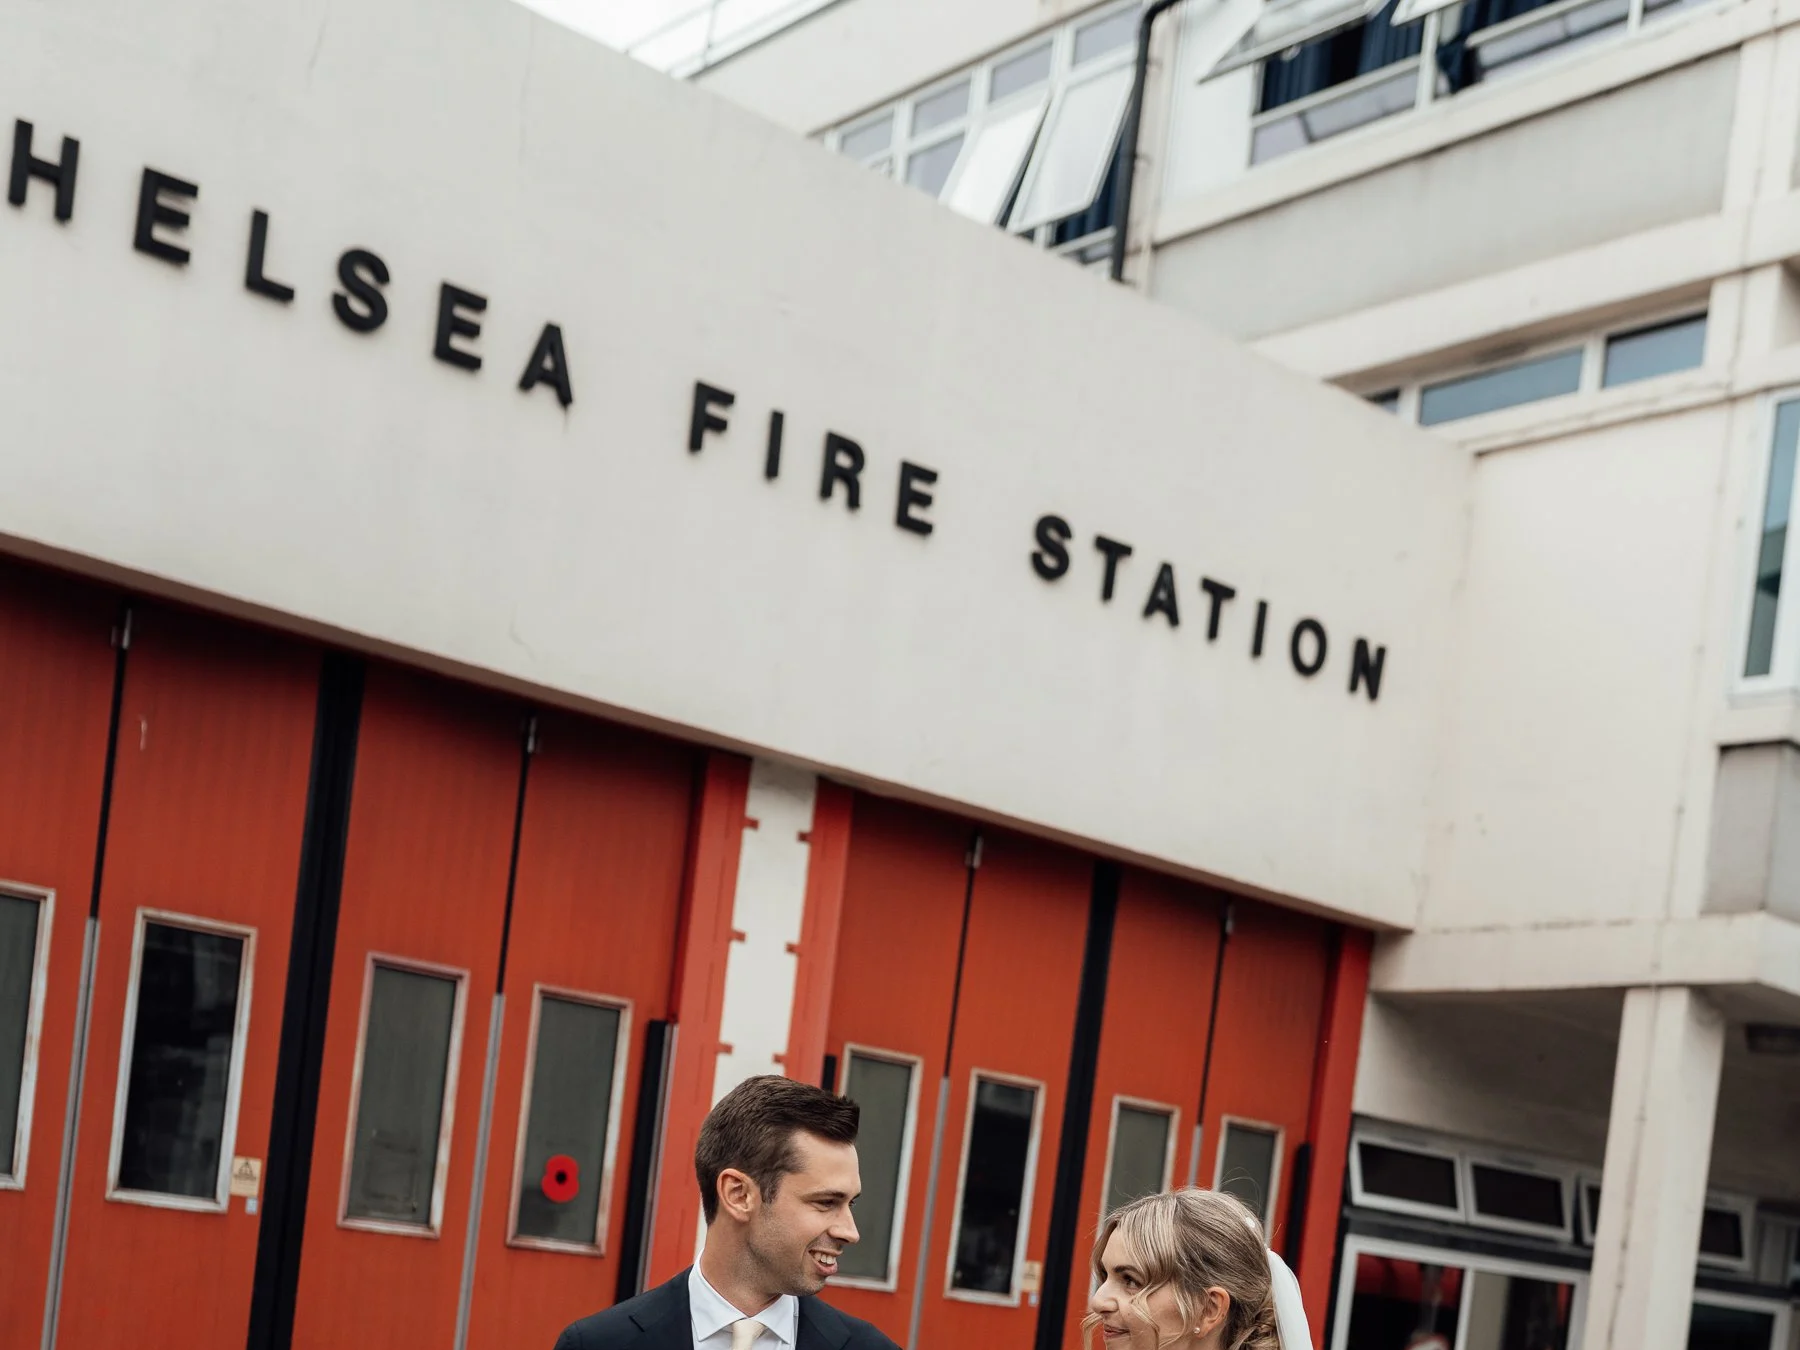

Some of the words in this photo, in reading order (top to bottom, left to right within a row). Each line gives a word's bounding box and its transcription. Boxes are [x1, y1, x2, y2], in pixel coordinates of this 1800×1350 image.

[8, 119, 573, 411] HELSEA
[689, 382, 938, 537] FIRE
[1031, 515, 1386, 701] STATION
